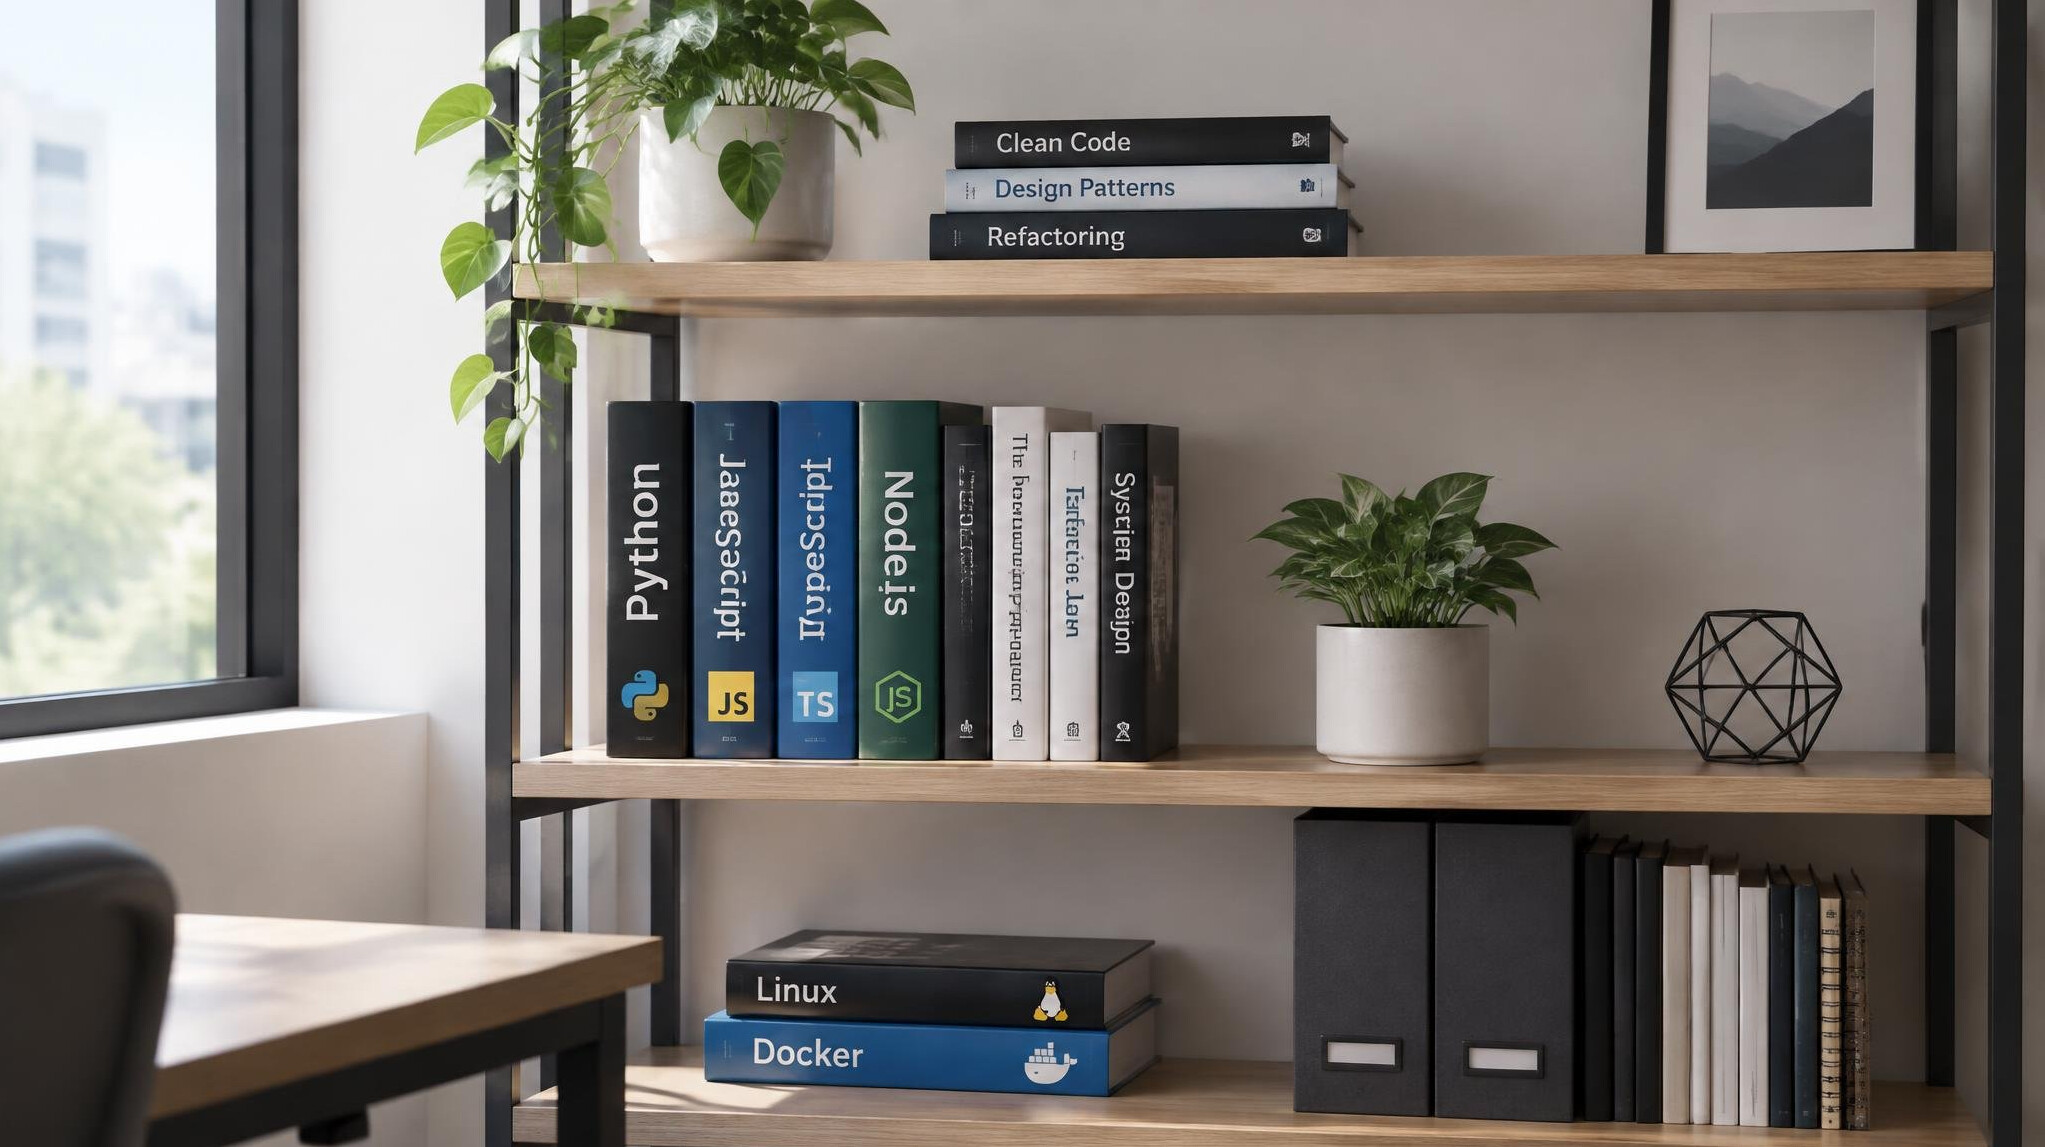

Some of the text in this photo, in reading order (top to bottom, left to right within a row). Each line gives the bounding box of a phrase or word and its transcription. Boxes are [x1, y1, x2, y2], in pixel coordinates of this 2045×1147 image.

[996, 130, 1131, 153] Clean Code
[995, 178, 1072, 202] Design
[1080, 178, 1176, 197] Patterns
[987, 226, 1125, 251] Refactoring
[624, 463, 668, 621] Python
[717, 691, 749, 716] JS
[797, 691, 834, 718] TS
[886, 686, 912, 713] JS
[757, 976, 838, 1004] Linux
[753, 1037, 864, 1068] Docker
